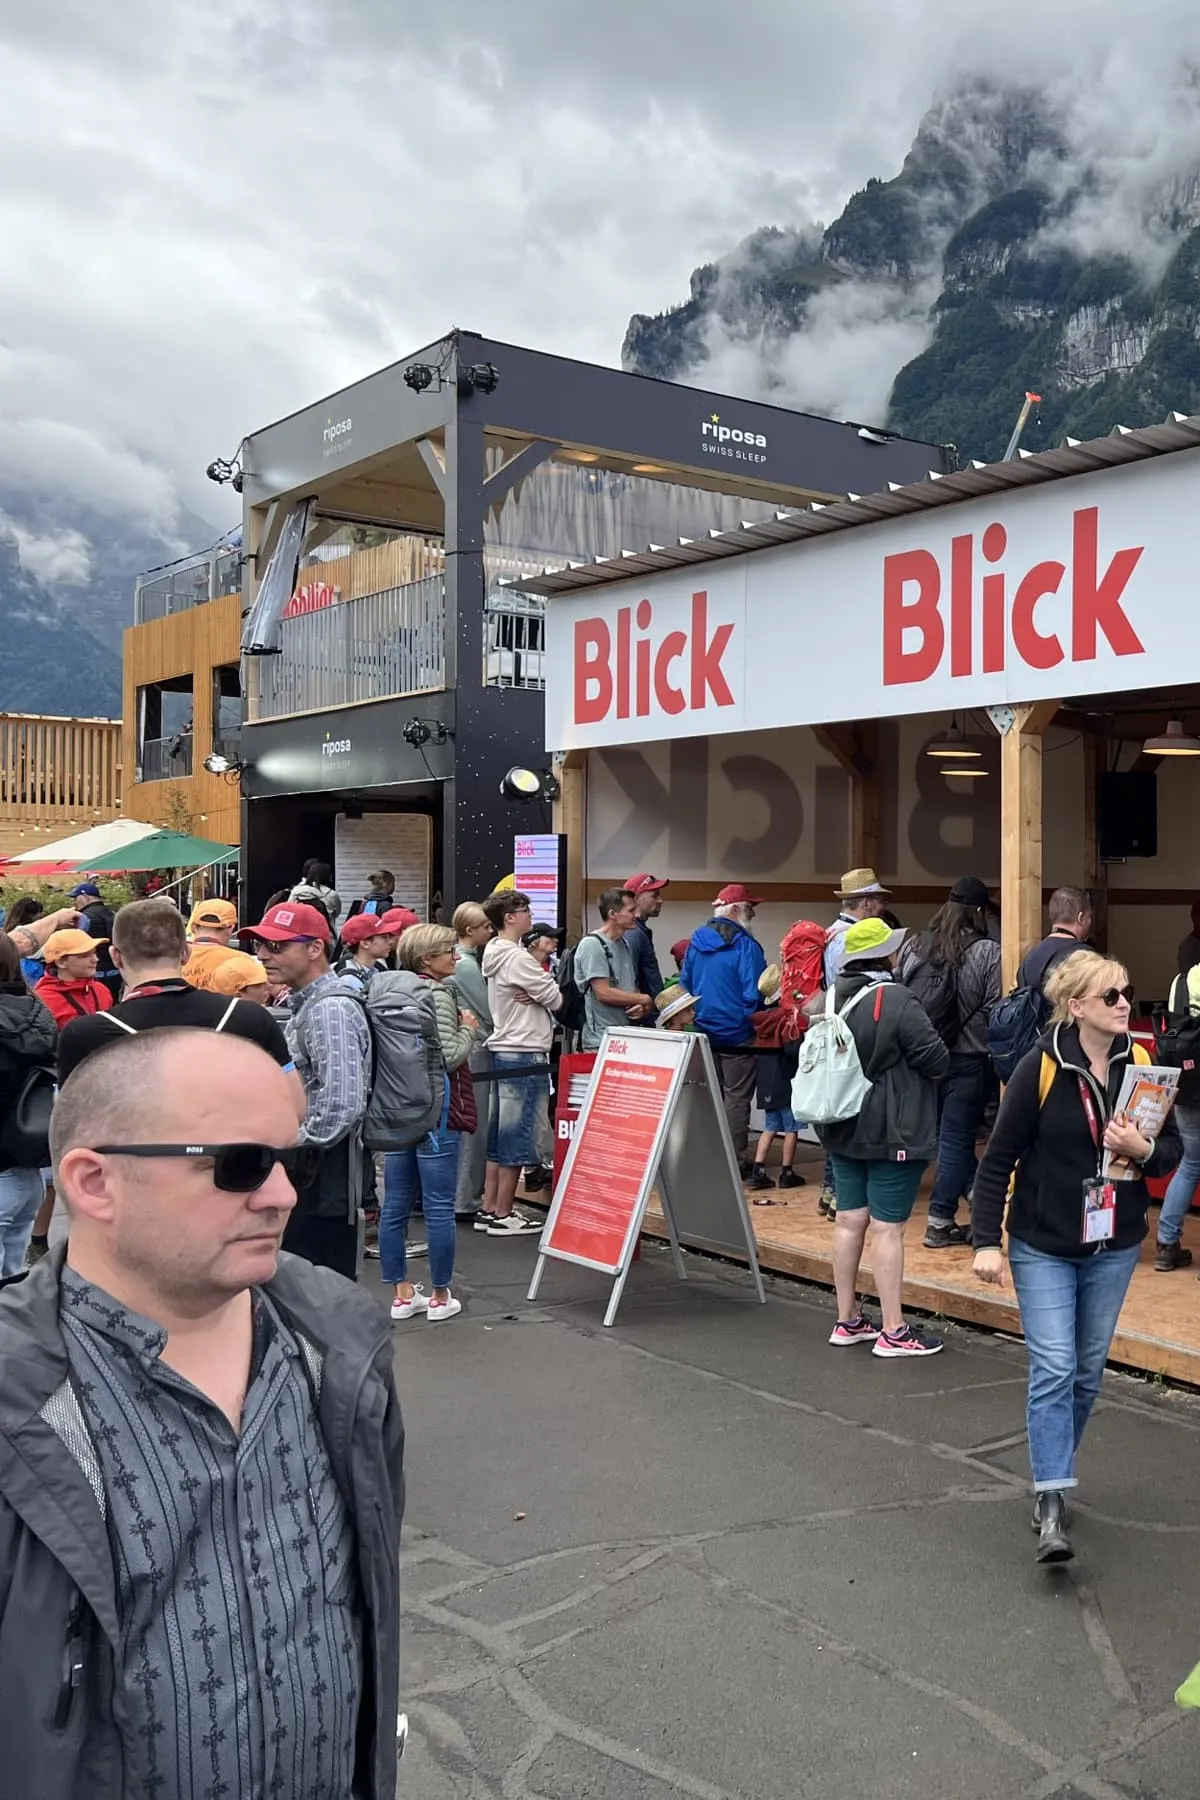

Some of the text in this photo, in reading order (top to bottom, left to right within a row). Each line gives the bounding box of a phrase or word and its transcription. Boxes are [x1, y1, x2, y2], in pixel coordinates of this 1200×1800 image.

[323, 418, 352, 442] riposa
[702, 413, 767, 448] riposa
[702, 443, 767, 463] SWISS SLEEP
[883, 506, 1145, 686] Blick
[574, 591, 735, 725] Blick
[322, 732, 351, 757] riposa
[607, 1040, 628, 1054] Blick
